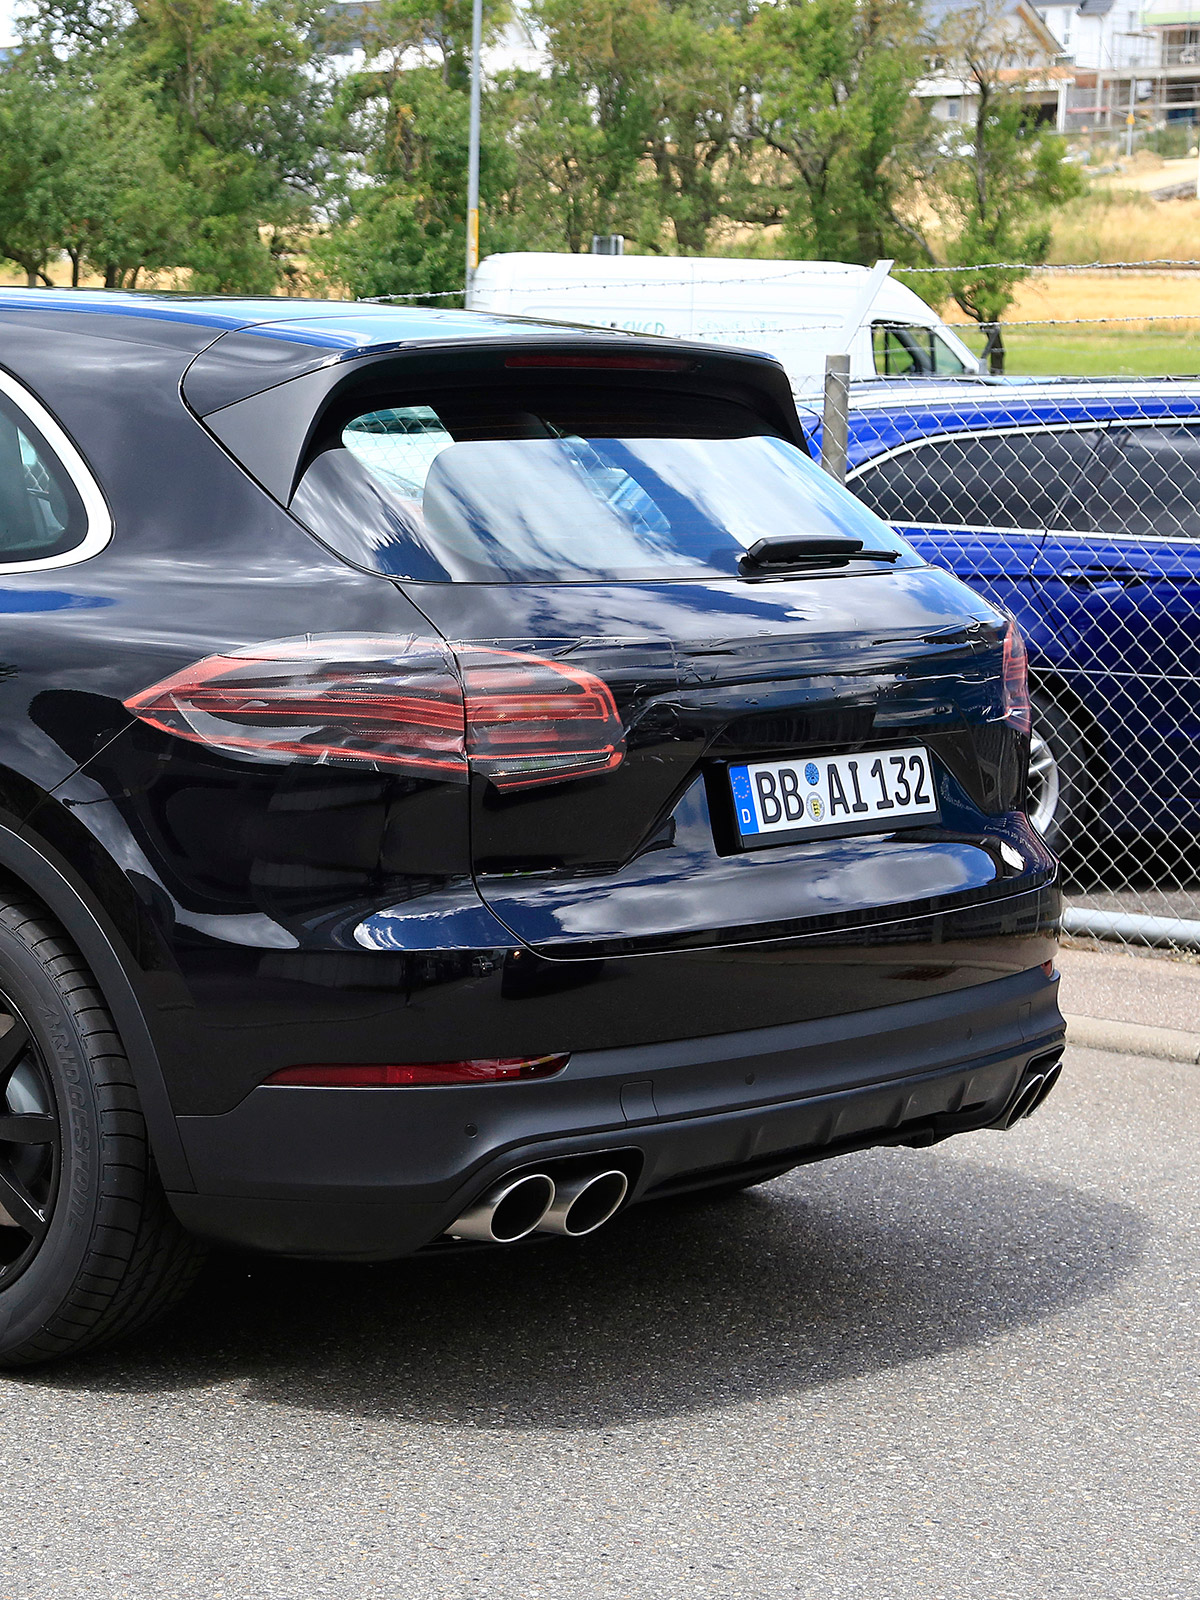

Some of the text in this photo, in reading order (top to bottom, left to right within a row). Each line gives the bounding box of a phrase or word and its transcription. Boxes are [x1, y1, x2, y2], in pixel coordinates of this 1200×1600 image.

[742, 808, 751, 824] D
[755, 755, 931, 825] BB AI 132
[40, 1005, 91, 1235] BRIDGESTONE
